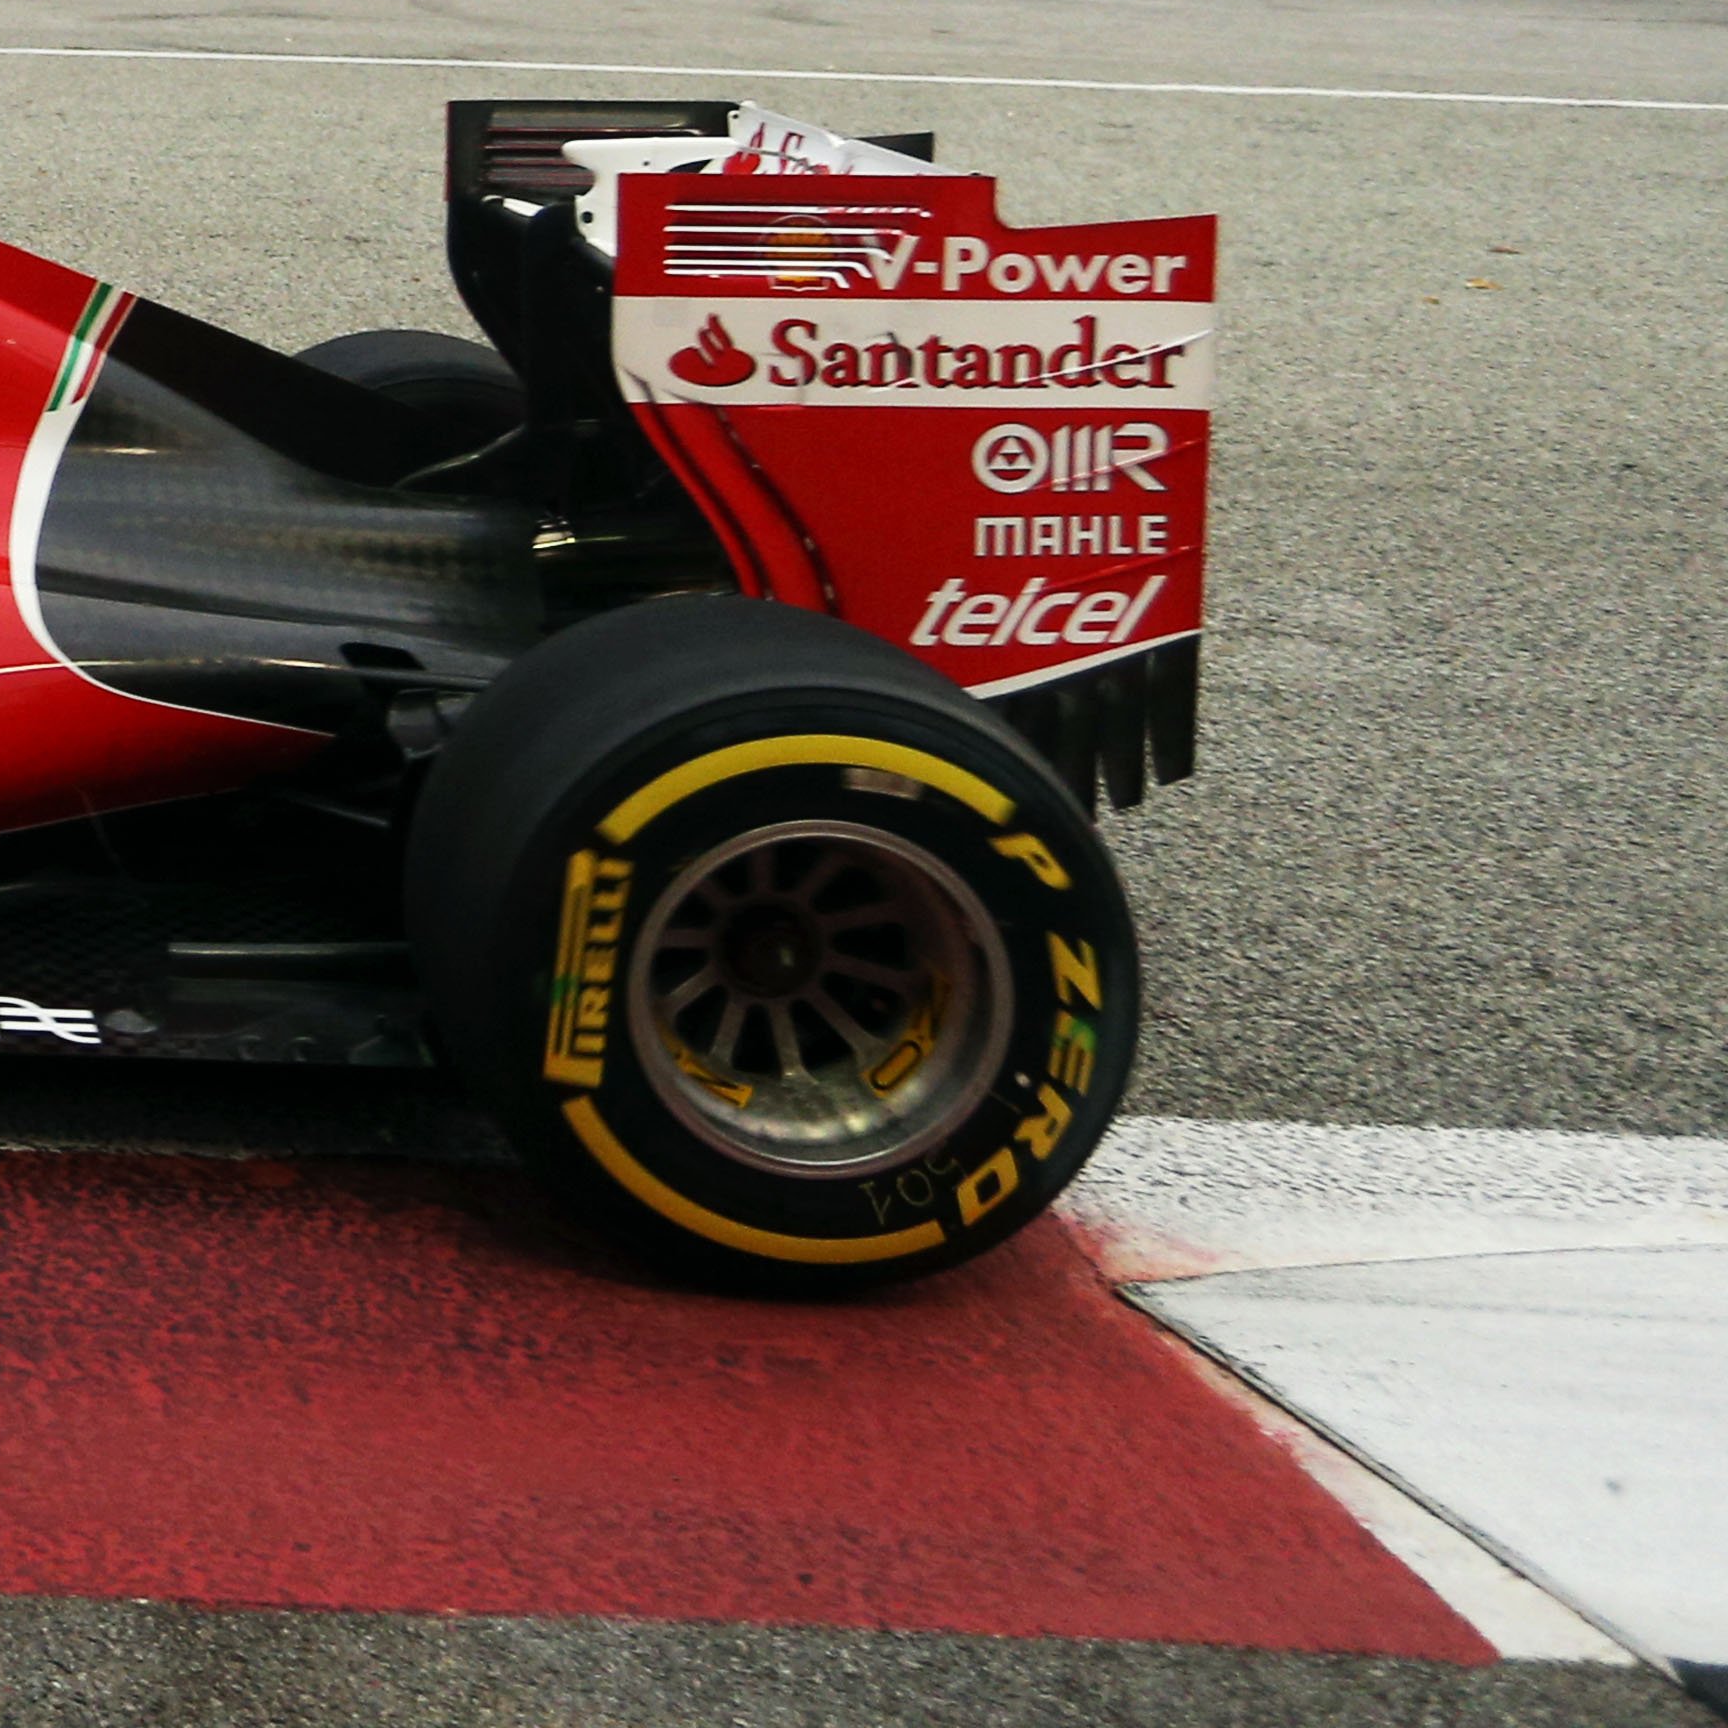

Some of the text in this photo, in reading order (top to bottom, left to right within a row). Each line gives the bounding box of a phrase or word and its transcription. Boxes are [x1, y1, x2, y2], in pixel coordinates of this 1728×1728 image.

[860, 235, 1187, 293] V-Power
[769, 315, 1185, 389] Santander
[976, 516, 1167, 556] MAHLE
[910, 575, 1167, 647] telcel
[544, 848, 634, 1089] PIRELLI
[956, 833, 1103, 1227] P ZERO
